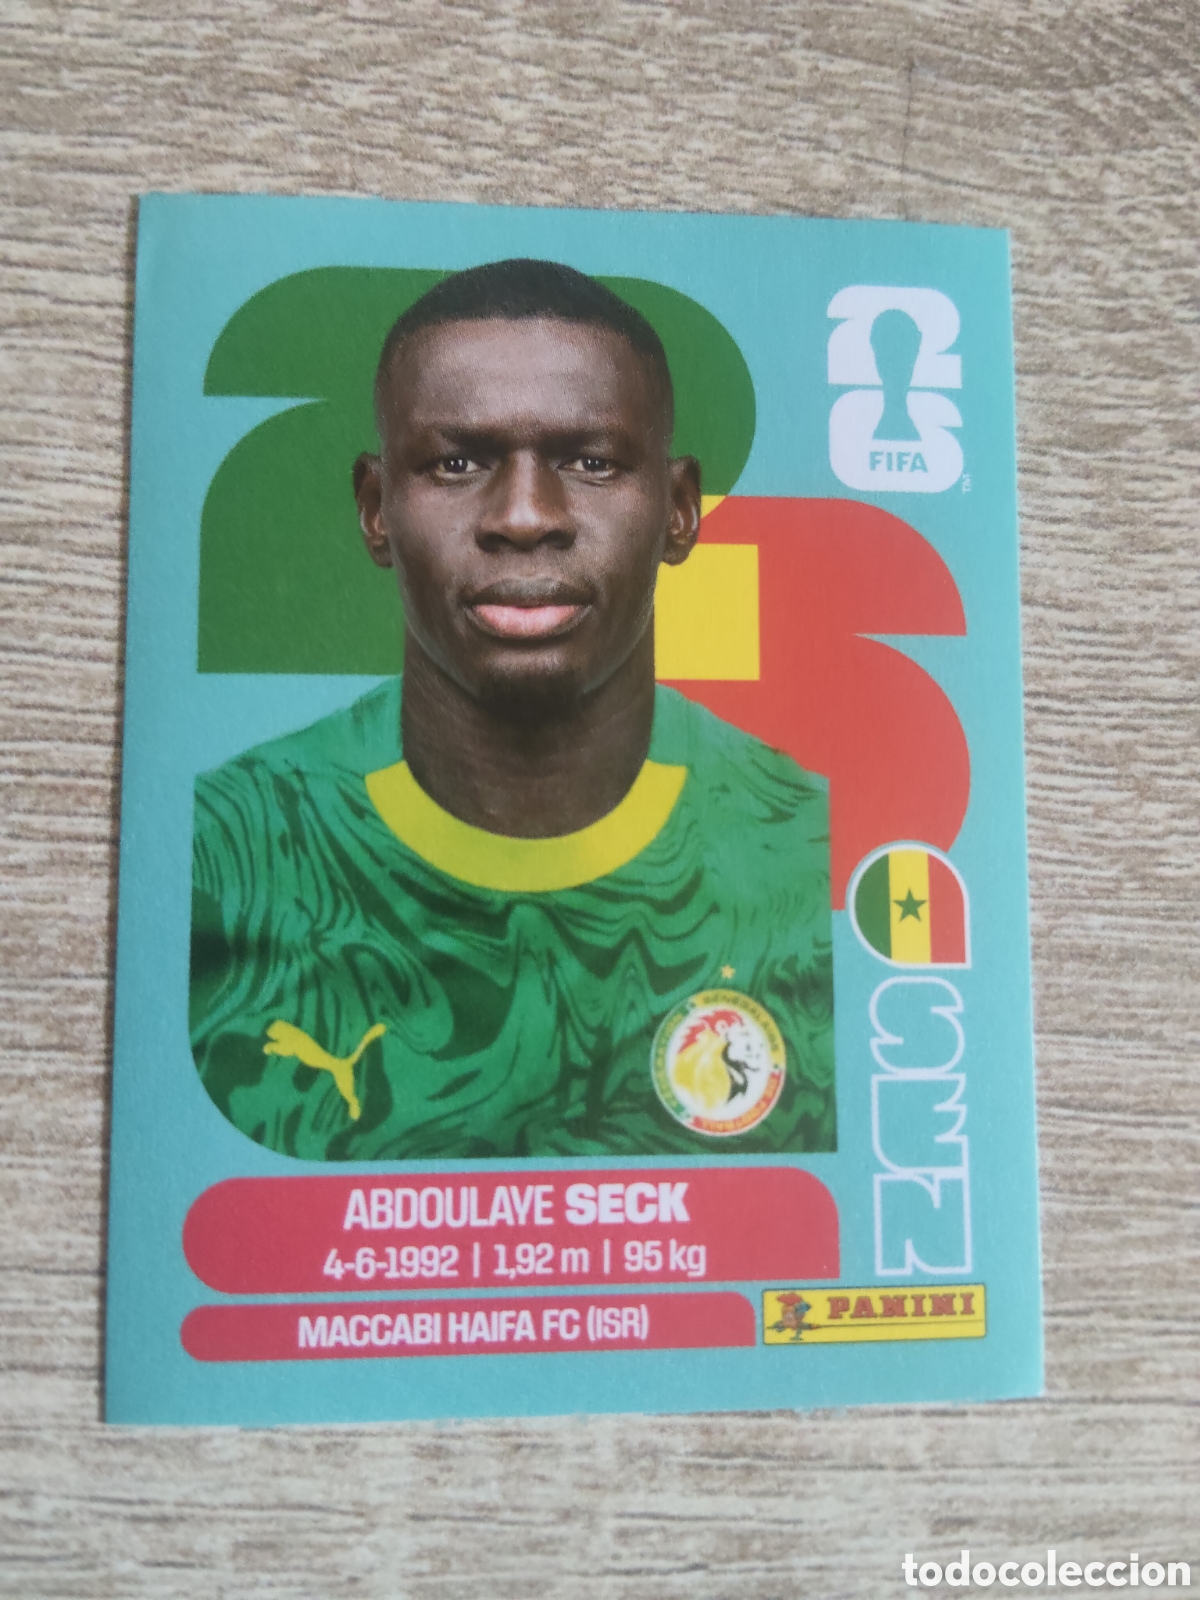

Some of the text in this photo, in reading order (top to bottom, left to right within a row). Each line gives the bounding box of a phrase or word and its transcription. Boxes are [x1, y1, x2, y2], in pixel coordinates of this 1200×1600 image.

[868, 451, 929, 473] FIFA
[343, 1182, 691, 1231] ABDOULAYE SECK
[323, 1245, 459, 1279] 4-6-1992
[494, 1243, 554, 1279] 1,92
[560, 1246, 590, 1273] m
[623, 1240, 663, 1272] 95
[669, 1239, 707, 1277] kg
[296, 1304, 649, 1349] MACCABI HAIFA FC (ISR)
[827, 1292, 976, 1321] PANINI
